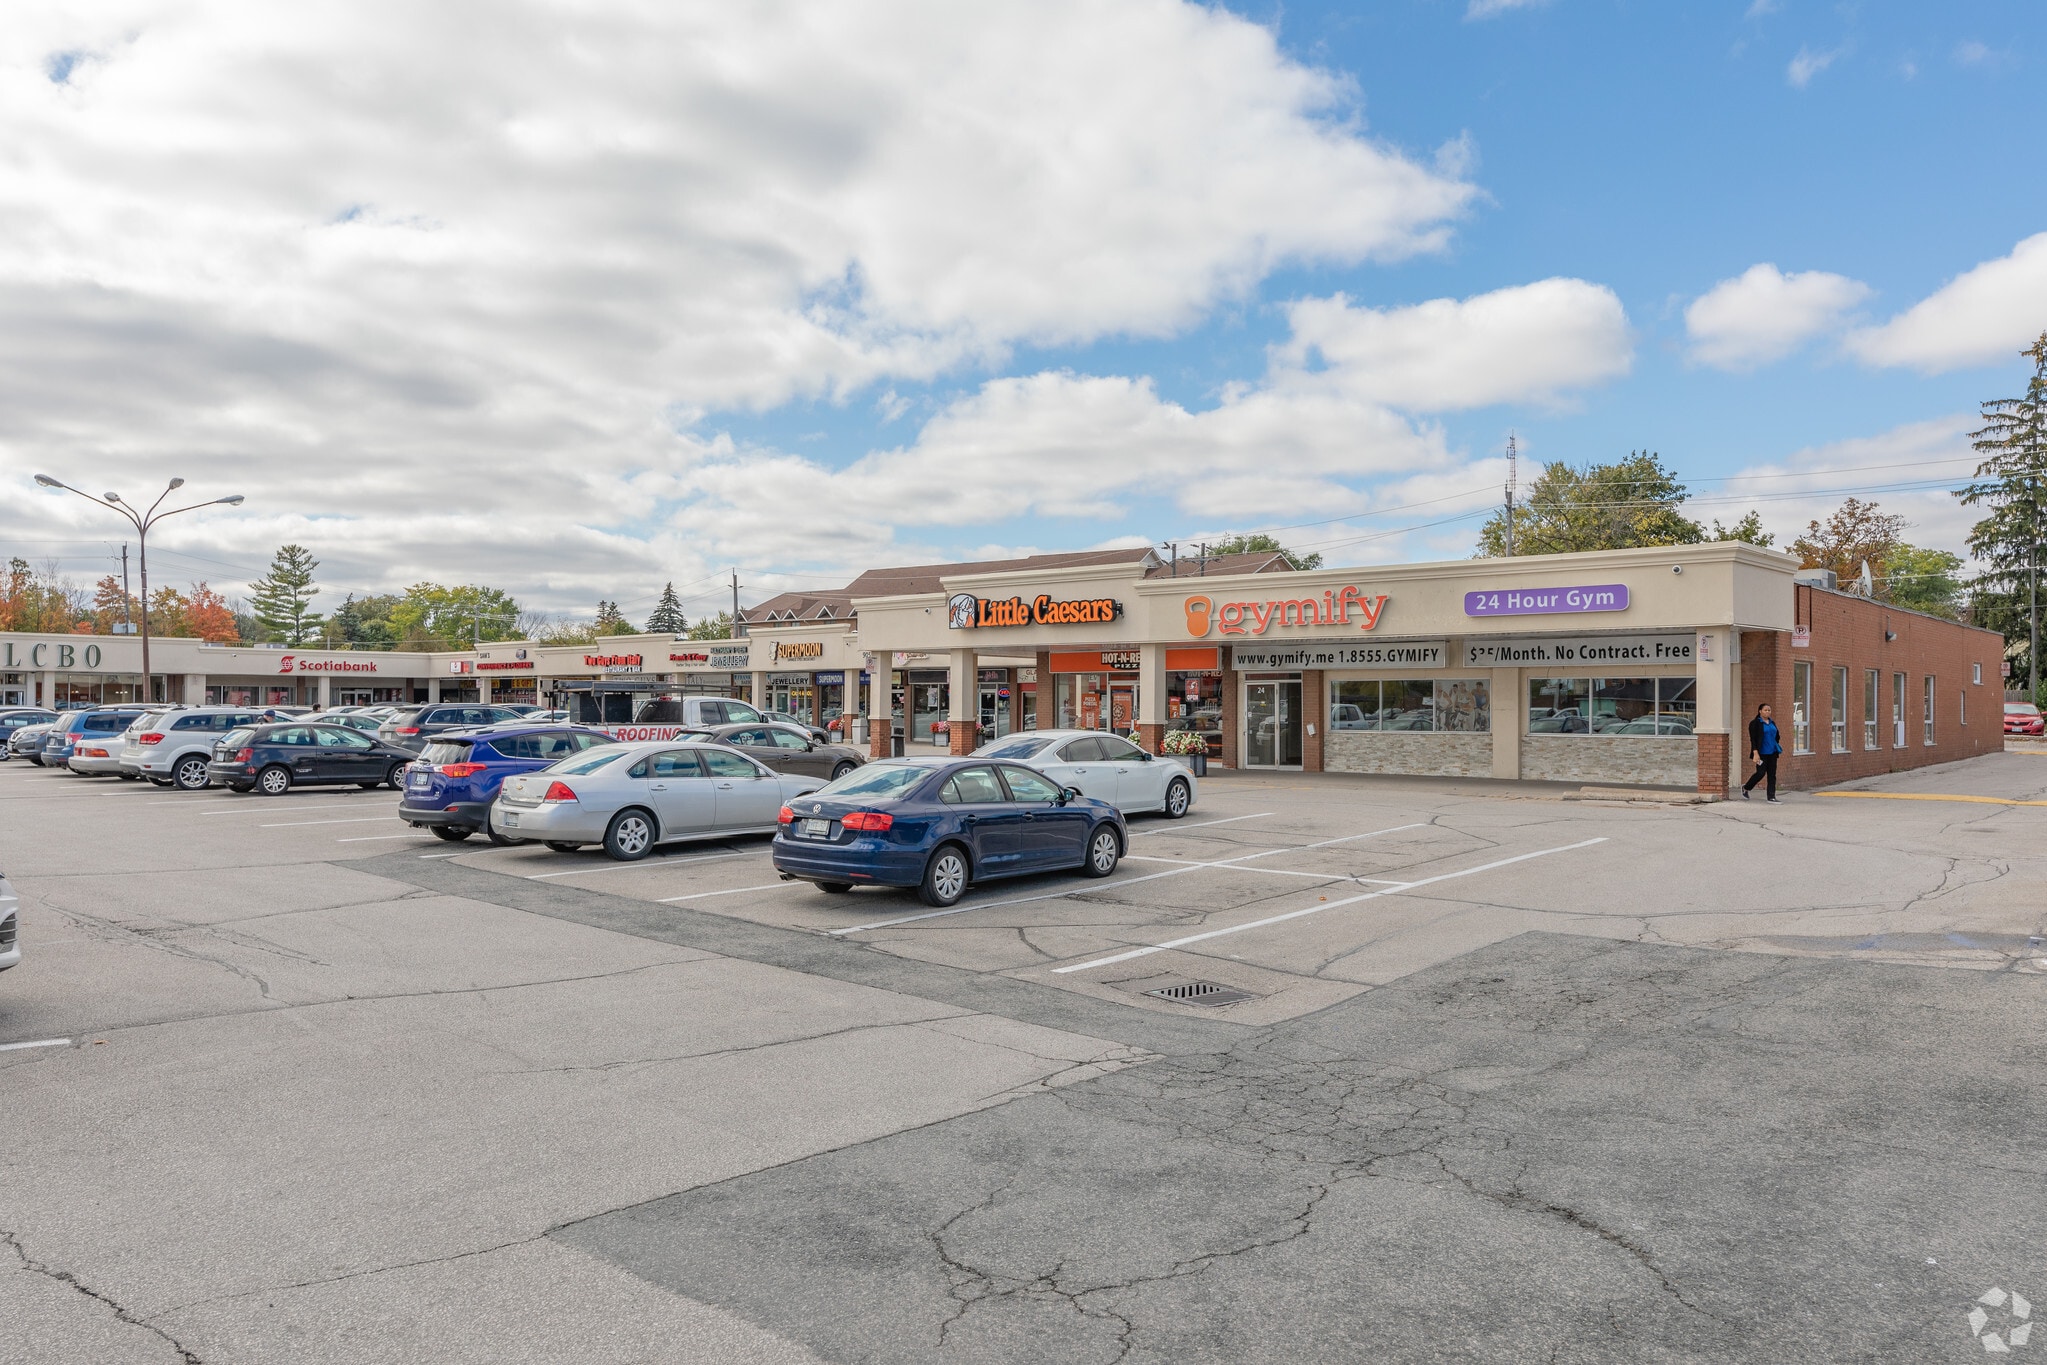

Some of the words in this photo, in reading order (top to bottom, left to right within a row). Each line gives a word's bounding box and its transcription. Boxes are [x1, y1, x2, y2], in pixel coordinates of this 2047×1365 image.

[1476, 595, 1500, 610] 24
[1508, 592, 1558, 609] Hour
[1566, 590, 1615, 609] Gym
[977, 597, 1029, 627] Little
[1033, 595, 1114, 624] Caesars
[1218, 586, 1388, 635] gymify
[5, 642, 102, 668] LCBO
[778, 642, 822, 658] SUPERMOON
[1102, 652, 1140, 664] HOT-N-RE
[1237, 652, 1334, 667] www.gymify.me
[1339, 648, 1439, 662] 1.8555.GYMIFY
[1556, 645, 1574, 660] No
[1580, 644, 1650, 659] Contract.
[1655, 643, 1690, 657] Free
[300, 660, 377, 672] Scotiabank
[584, 655, 596, 666] Two
[597, 655, 610, 667] Guys
[611, 654, 627, 666] From
[627, 653, 642, 665] Italy
[710, 655, 748, 667] JEWELLERY
[818, 675, 843, 683] SUPERMOON
[616, 727, 681, 741] ROOFING
